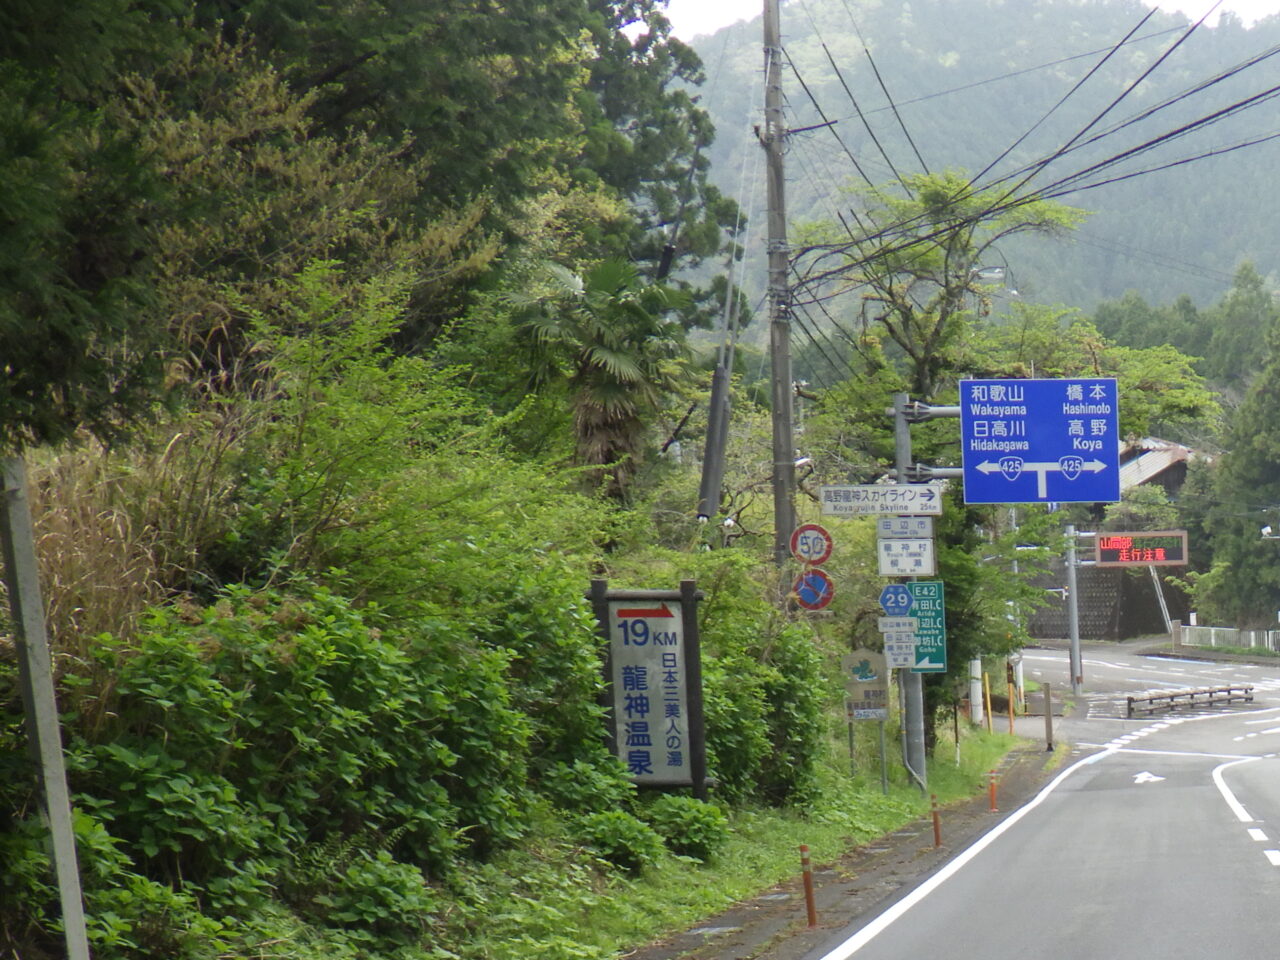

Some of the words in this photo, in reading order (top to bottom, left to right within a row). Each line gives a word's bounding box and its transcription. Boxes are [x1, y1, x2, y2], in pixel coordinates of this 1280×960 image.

[971, 384, 1024, 402] 和歌山
[1066, 384, 1106, 400] 橋本
[971, 404, 1026, 417] Wakayama
[1063, 403, 1111, 415] Hashimoto
[973, 420, 1025, 437] 日高川
[1068, 419, 1107, 436] 高野
[971, 440, 1029, 452] Hidakagawa
[1073, 438, 1103, 451] Koya
[1002, 461, 1021, 472] 425
[1063, 460, 1081, 472] 425
[824, 489, 917, 503] 高野龍神スカイライン
[880, 503, 909, 513] Skyline
[883, 521, 926, 530] 田辺市
[800, 536, 824, 555] 50
[1100, 537, 1133, 549] 山間部
[1119, 548, 1166, 561] 走行注意
[915, 586, 936, 596] E42
[886, 594, 908, 607] 29
[617, 619, 650, 646] 19
[653, 632, 677, 646] KM
[661, 653, 683, 767] 日本三美人の湯
[621, 665, 654, 775] 龍神温泉
